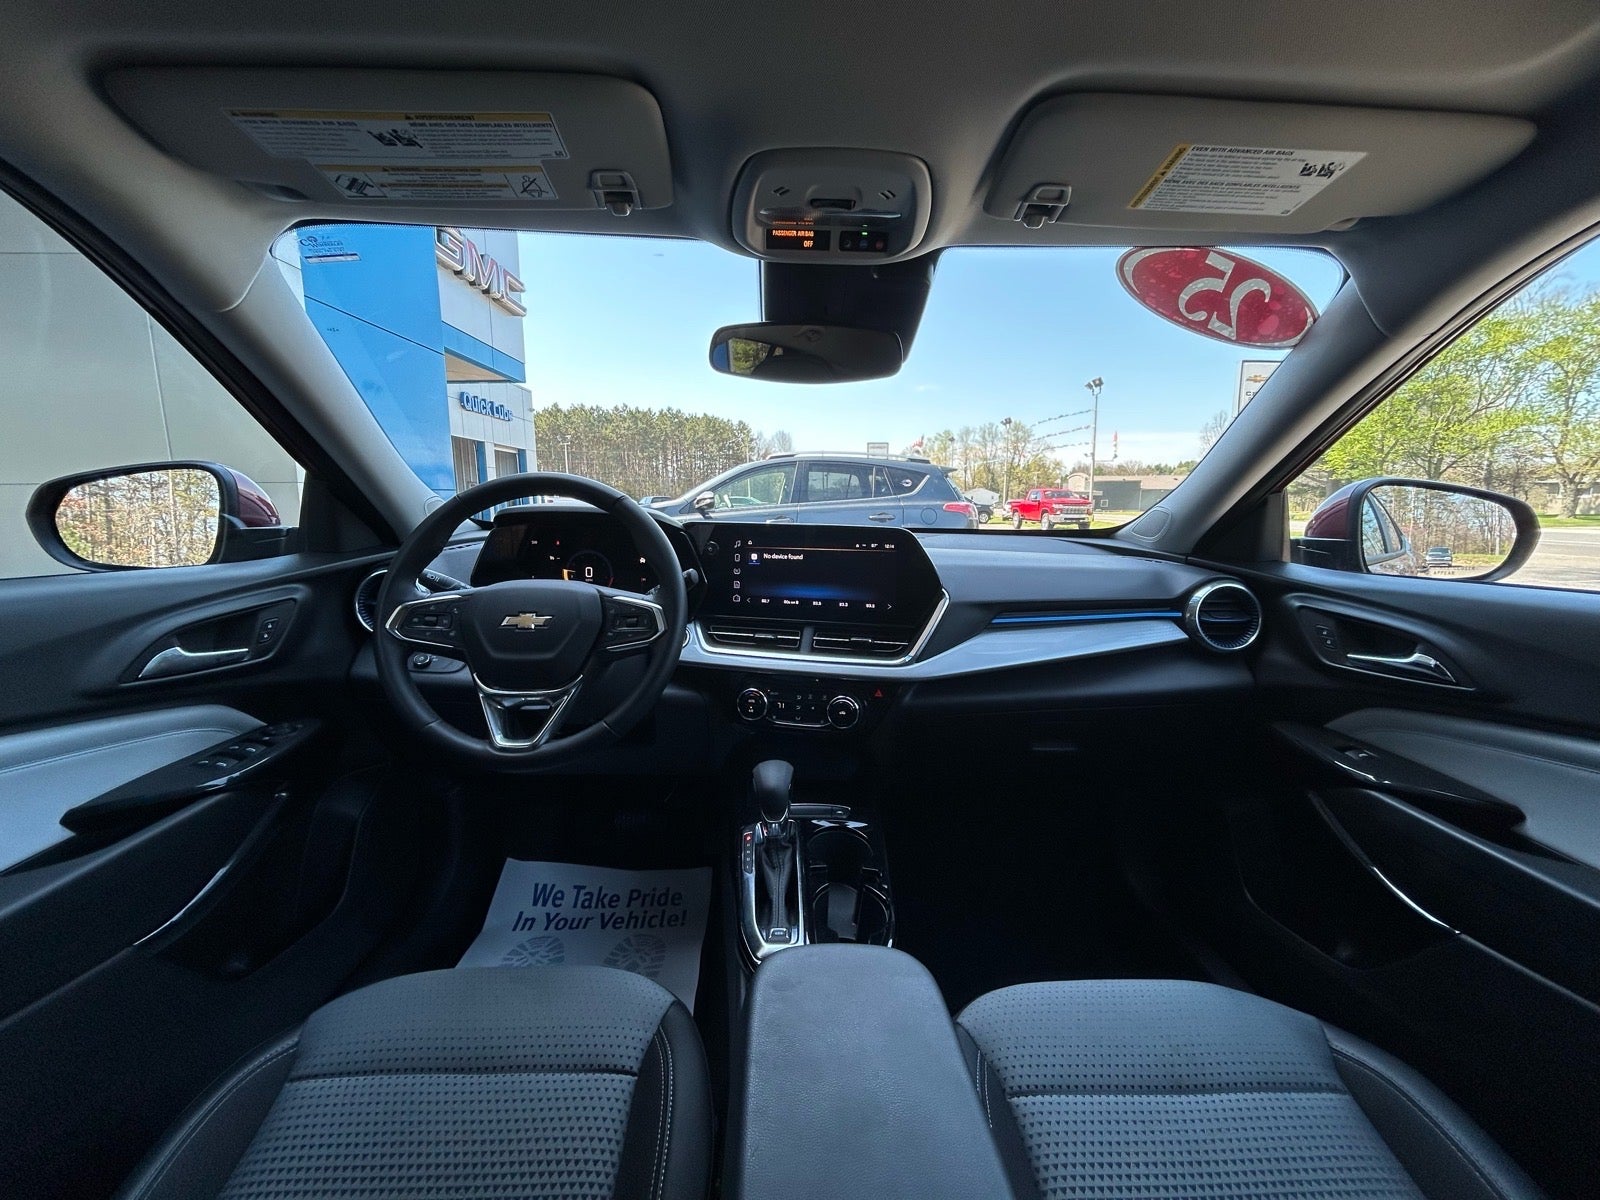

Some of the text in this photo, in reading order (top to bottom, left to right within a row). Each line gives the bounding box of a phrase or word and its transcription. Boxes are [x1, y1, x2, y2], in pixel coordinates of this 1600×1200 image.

[772, 229, 797, 237] PASSENGER
[803, 240, 814, 248] OFF
[434, 227, 527, 316] GMC
[462, 391, 495, 417] QUICK
[763, 552, 804, 561] No device found
[585, 566, 593, 578] 0
[532, 882, 684, 910] We Take Pride
[511, 910, 687, 932] In Your Vehicle!
